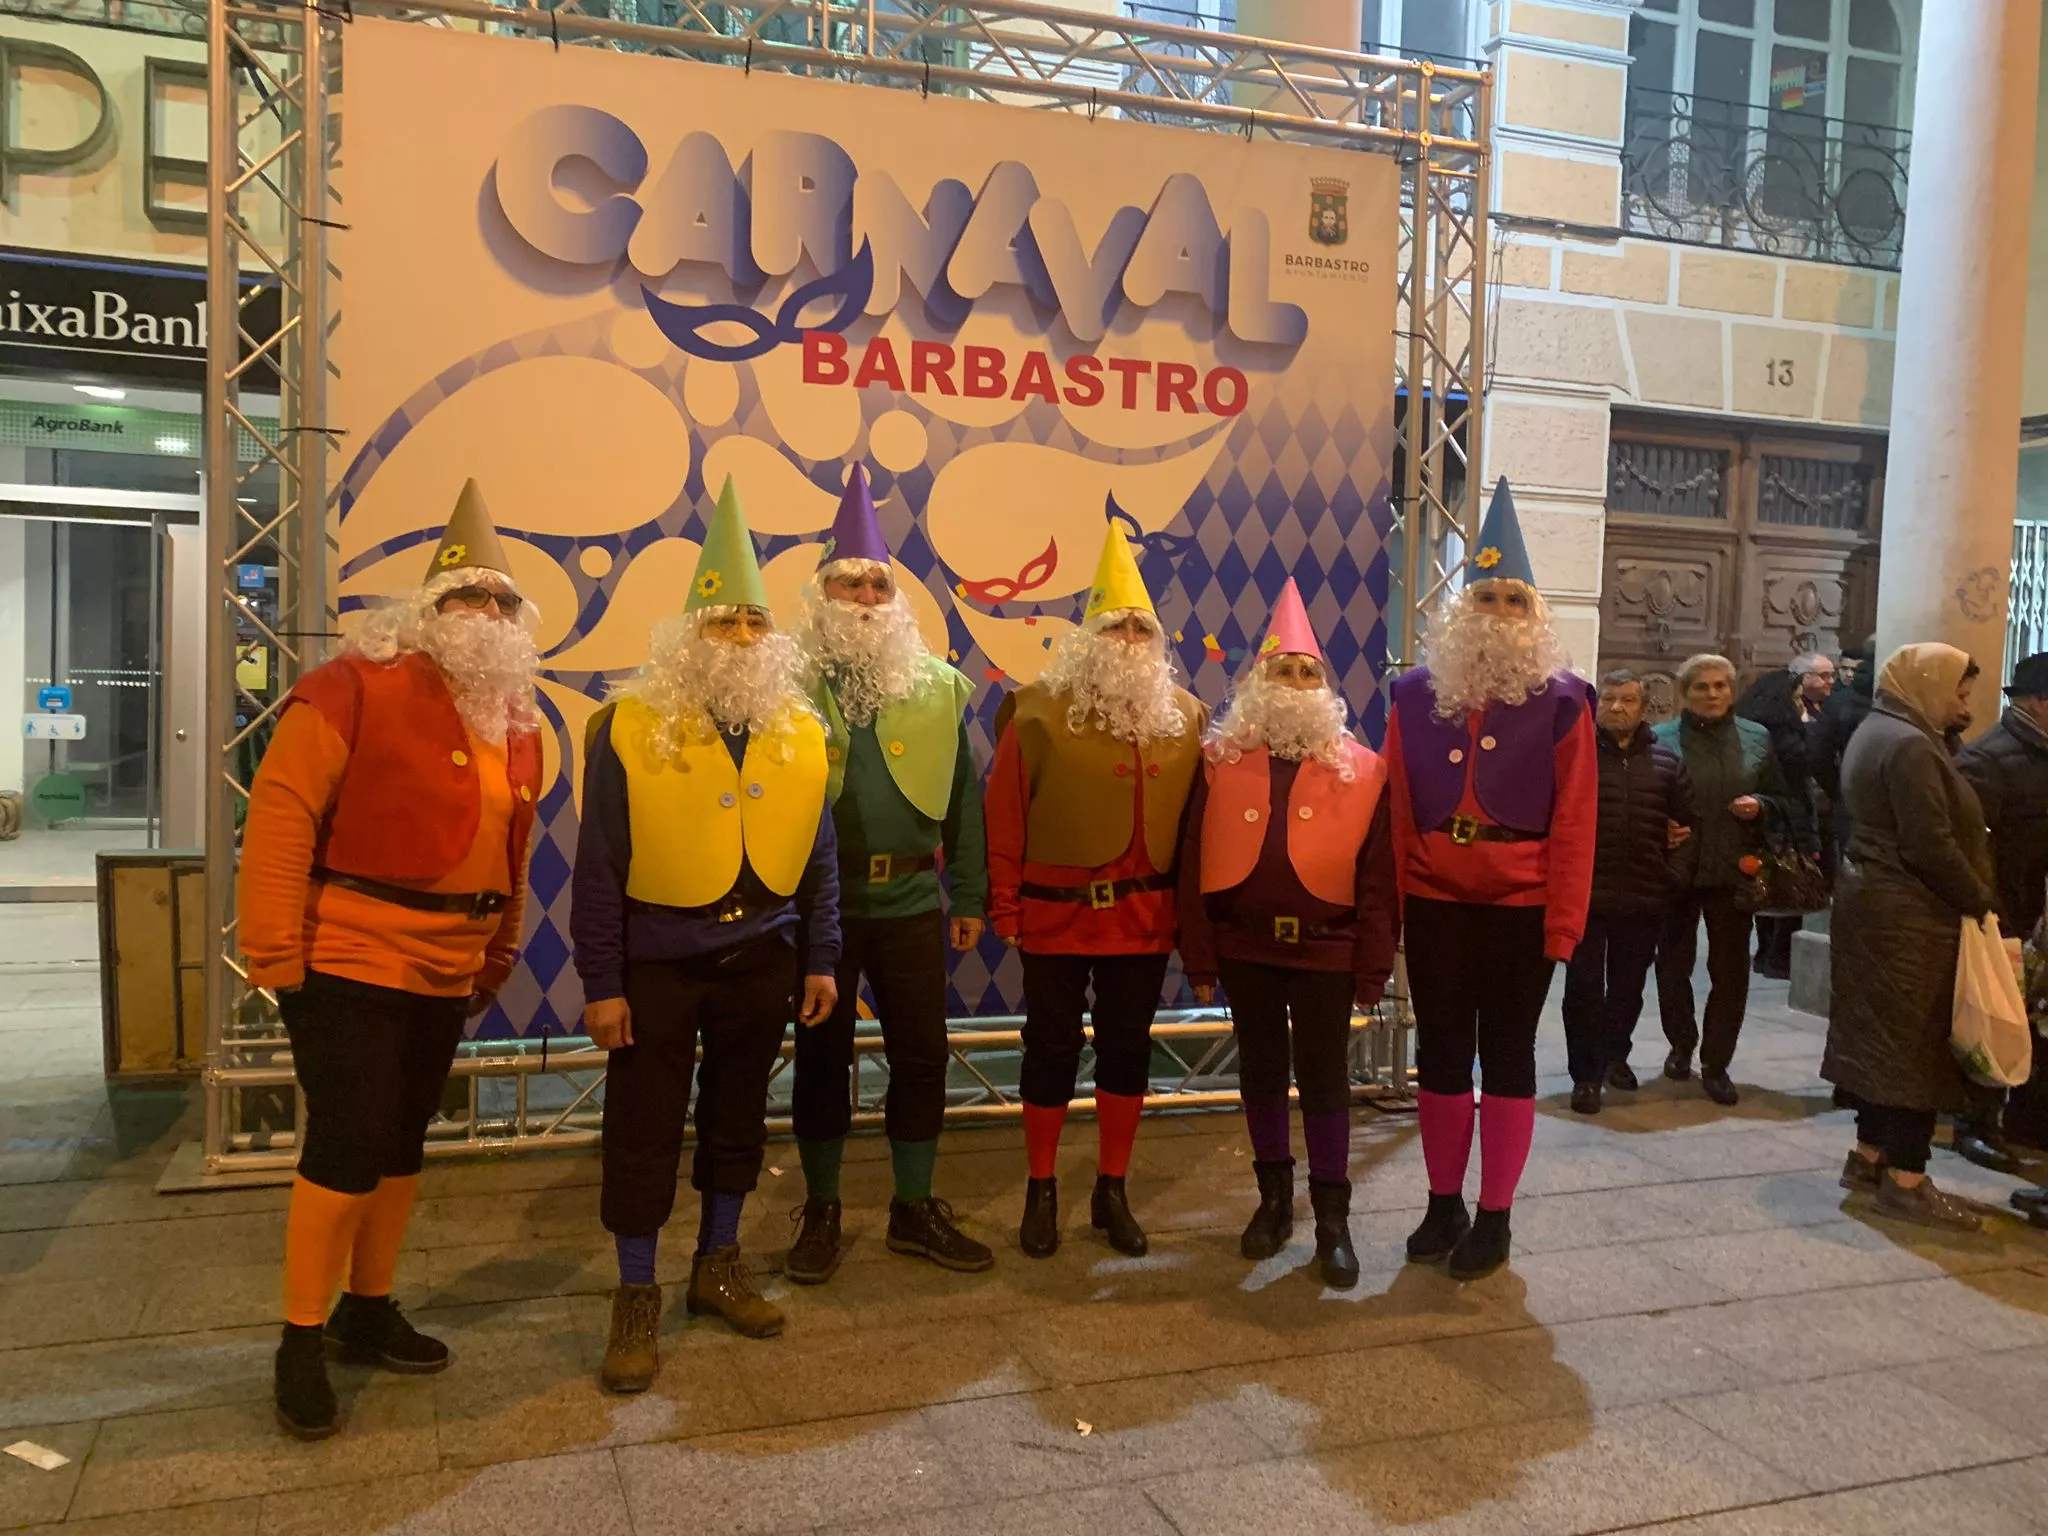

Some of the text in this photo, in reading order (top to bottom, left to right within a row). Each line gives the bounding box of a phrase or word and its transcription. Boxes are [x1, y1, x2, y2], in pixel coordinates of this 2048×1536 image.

[495, 104, 1309, 347] CARNAVAL
[1285, 253, 1369, 273] BARBASTRO
[0, 290, 208, 348] ixaBan
[802, 330, 1249, 417] BARBASTRO
[1766, 357, 1794, 387] 13
[32, 415, 124, 434] AgroBank
